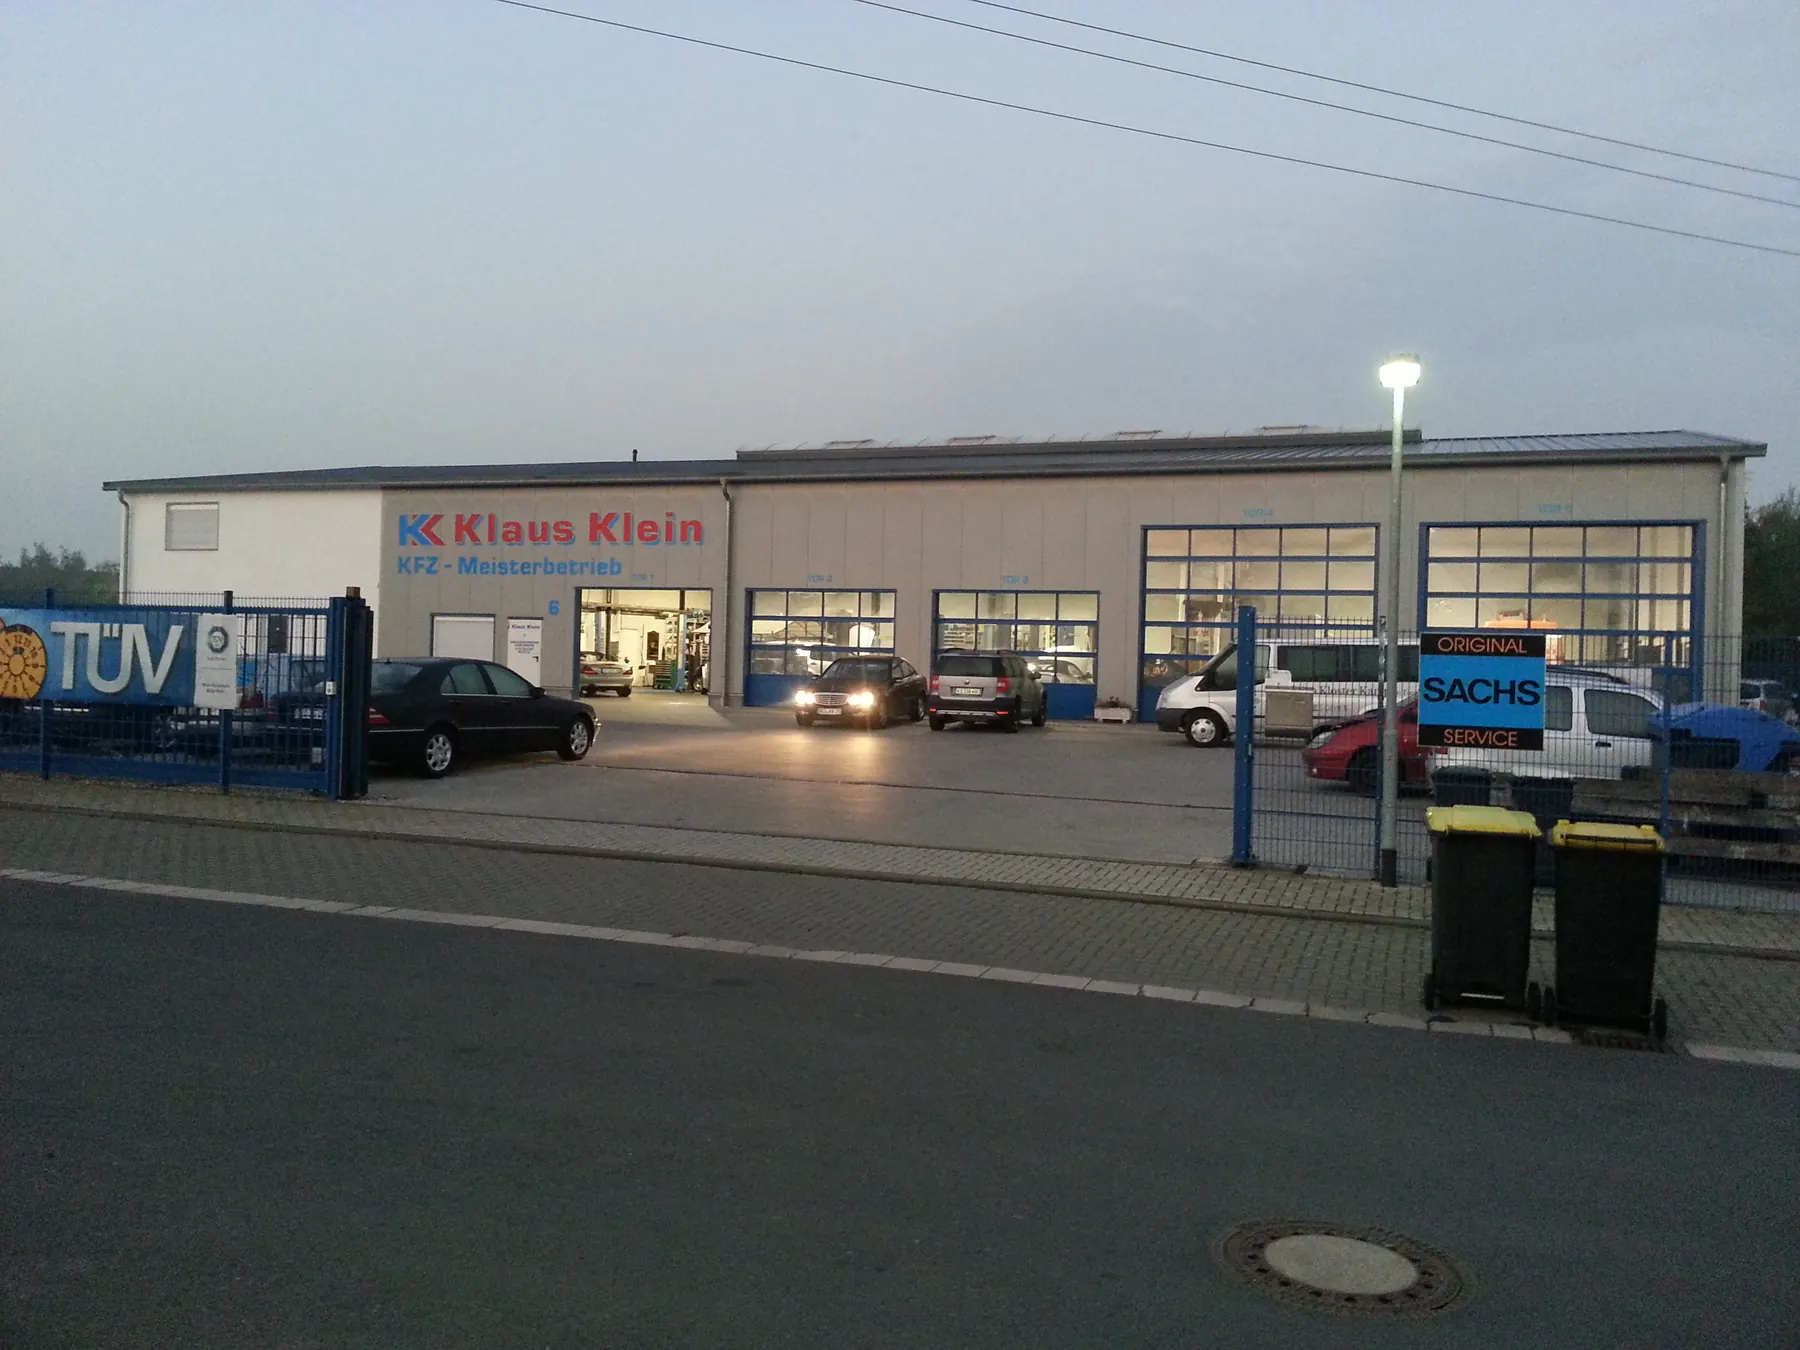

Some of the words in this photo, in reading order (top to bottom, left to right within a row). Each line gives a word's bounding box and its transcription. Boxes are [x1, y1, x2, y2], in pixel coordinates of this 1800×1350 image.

[454, 513, 576, 546] Klaus
[588, 511, 705, 546] Klein
[397, 557, 438, 575] KFZ
[458, 556, 623, 576] Meisterbetrieb
[548, 600, 560, 616] 6
[1437, 636, 1527, 654] ORIGINAL
[50, 621, 184, 695] TÜV
[1423, 677, 1541, 706] SACHS
[1443, 728, 1518, 747] SERVICE
